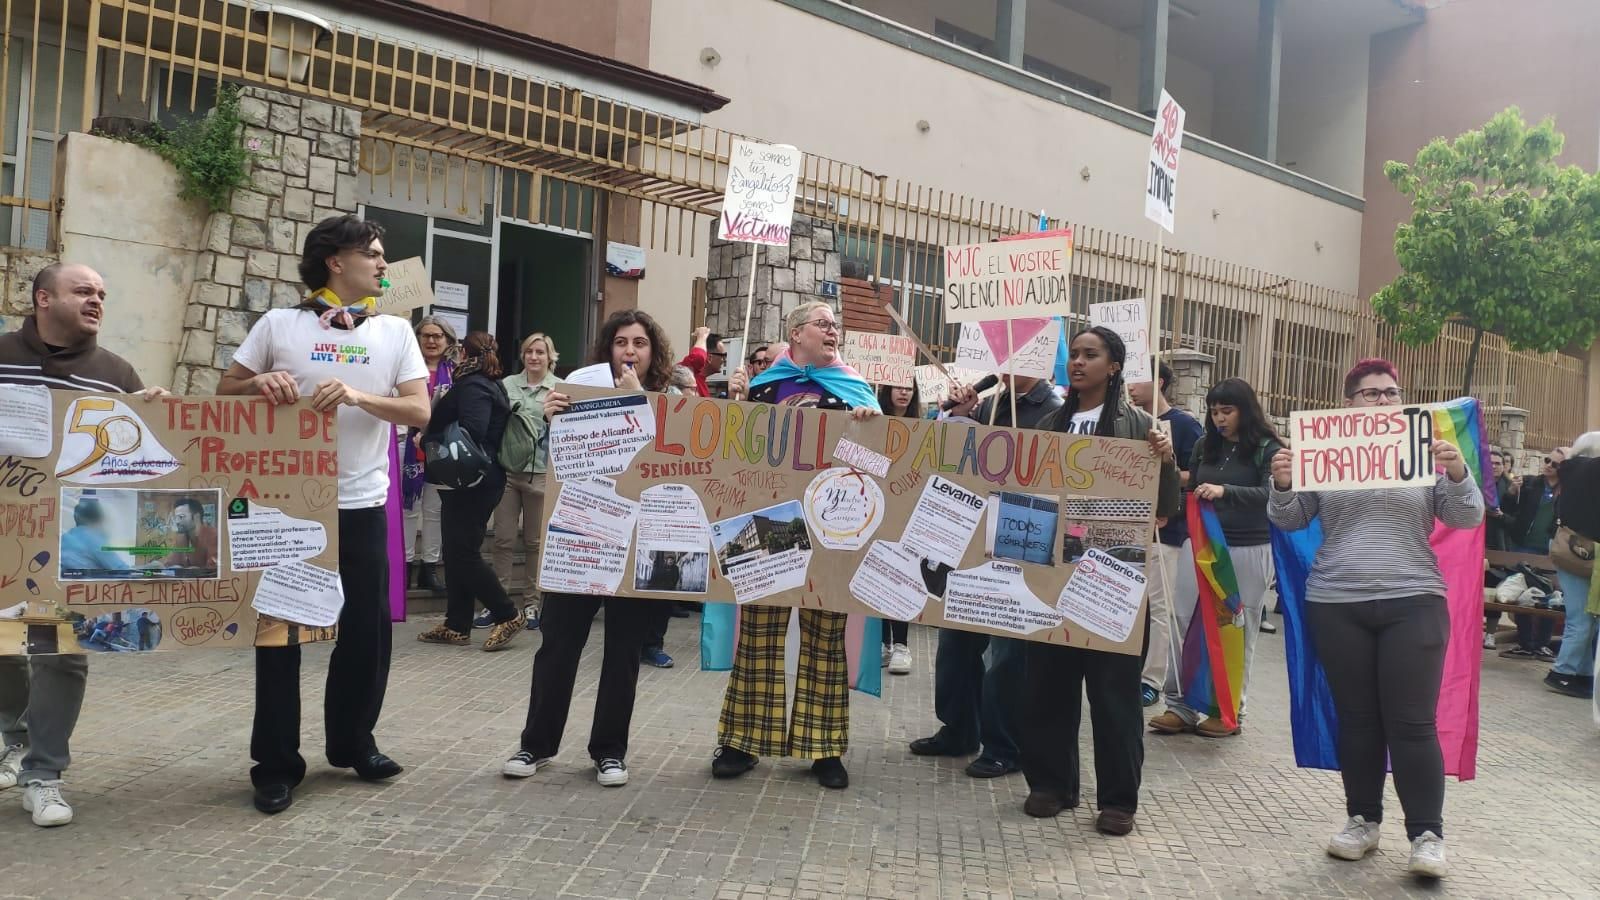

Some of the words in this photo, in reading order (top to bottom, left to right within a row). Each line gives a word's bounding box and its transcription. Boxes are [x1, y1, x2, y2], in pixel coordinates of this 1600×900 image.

[1162, 99, 1178, 139] 40
[1152, 131, 1178, 170] ANYS
[947, 247, 981, 278] MJC
[988, 255, 1005, 274] EL
[1009, 250, 1062, 272] VOSTRE
[948, 280, 999, 309] SILENCI
[1004, 278, 1024, 306] NO
[1025, 274, 1067, 304] AJUDA
[963, 325, 980, 340] NO
[311, 352, 333, 362] LIVE
[336, 354, 370, 364] PROUD!
[314, 344, 337, 353] LIVE
[340, 344, 367, 355] LOUD!
[958, 347, 988, 361] ESTEM
[560, 413, 599, 423] Comunidad
[599, 408, 634, 418] Valenciana
[576, 399, 621, 410] VANGUARDIA
[162, 399, 276, 434] TENINT
[299, 408, 336, 443] DE
[1300, 411, 1406, 441] HOMOFOBS
[56, 400, 141, 478] 50
[551, 436, 559, 444] El
[560, 432, 588, 443] obispo
[589, 430, 599, 438] de
[600, 425, 634, 437] Alicante
[552, 444, 577, 455] apoya
[587, 437, 620, 450] profesor
[621, 433, 654, 444] acusado
[654, 394, 832, 471] L'ORGULL
[885, 419, 1095, 490] D'ALAQUÀS
[1400, 408, 1432, 481] JA
[101, 456, 128, 468] Años
[553, 454, 563, 462] de
[584, 447, 616, 459] terapias
[617, 446, 636, 454] para
[554, 460, 585, 471] revertir
[586, 458, 594, 466] la
[0, 456, 47, 497] MJC
[1301, 446, 1354, 487] FORA
[733, 468, 788, 490] TORTURES
[889, 470, 924, 496] CULPA
[704, 478, 747, 508] TRAUMA
[931, 477, 983, 509] Levante
[1001, 517, 1042, 535] TODOS
[992, 562, 1022, 572] Levante
[948, 589, 984, 601] Educación
[983, 594, 1009, 605] desoyó
[946, 605, 979, 615] educativa
[997, 612, 1022, 622] colegio
[1023, 616, 1055, 626] señalado
[947, 597, 1006, 611] recomendaciones
[1025, 609, 1064, 621] inspección
[181, 612, 218, 641] soles?
[958, 614, 985, 624] terapias
[986, 618, 1025, 630] homófobas
